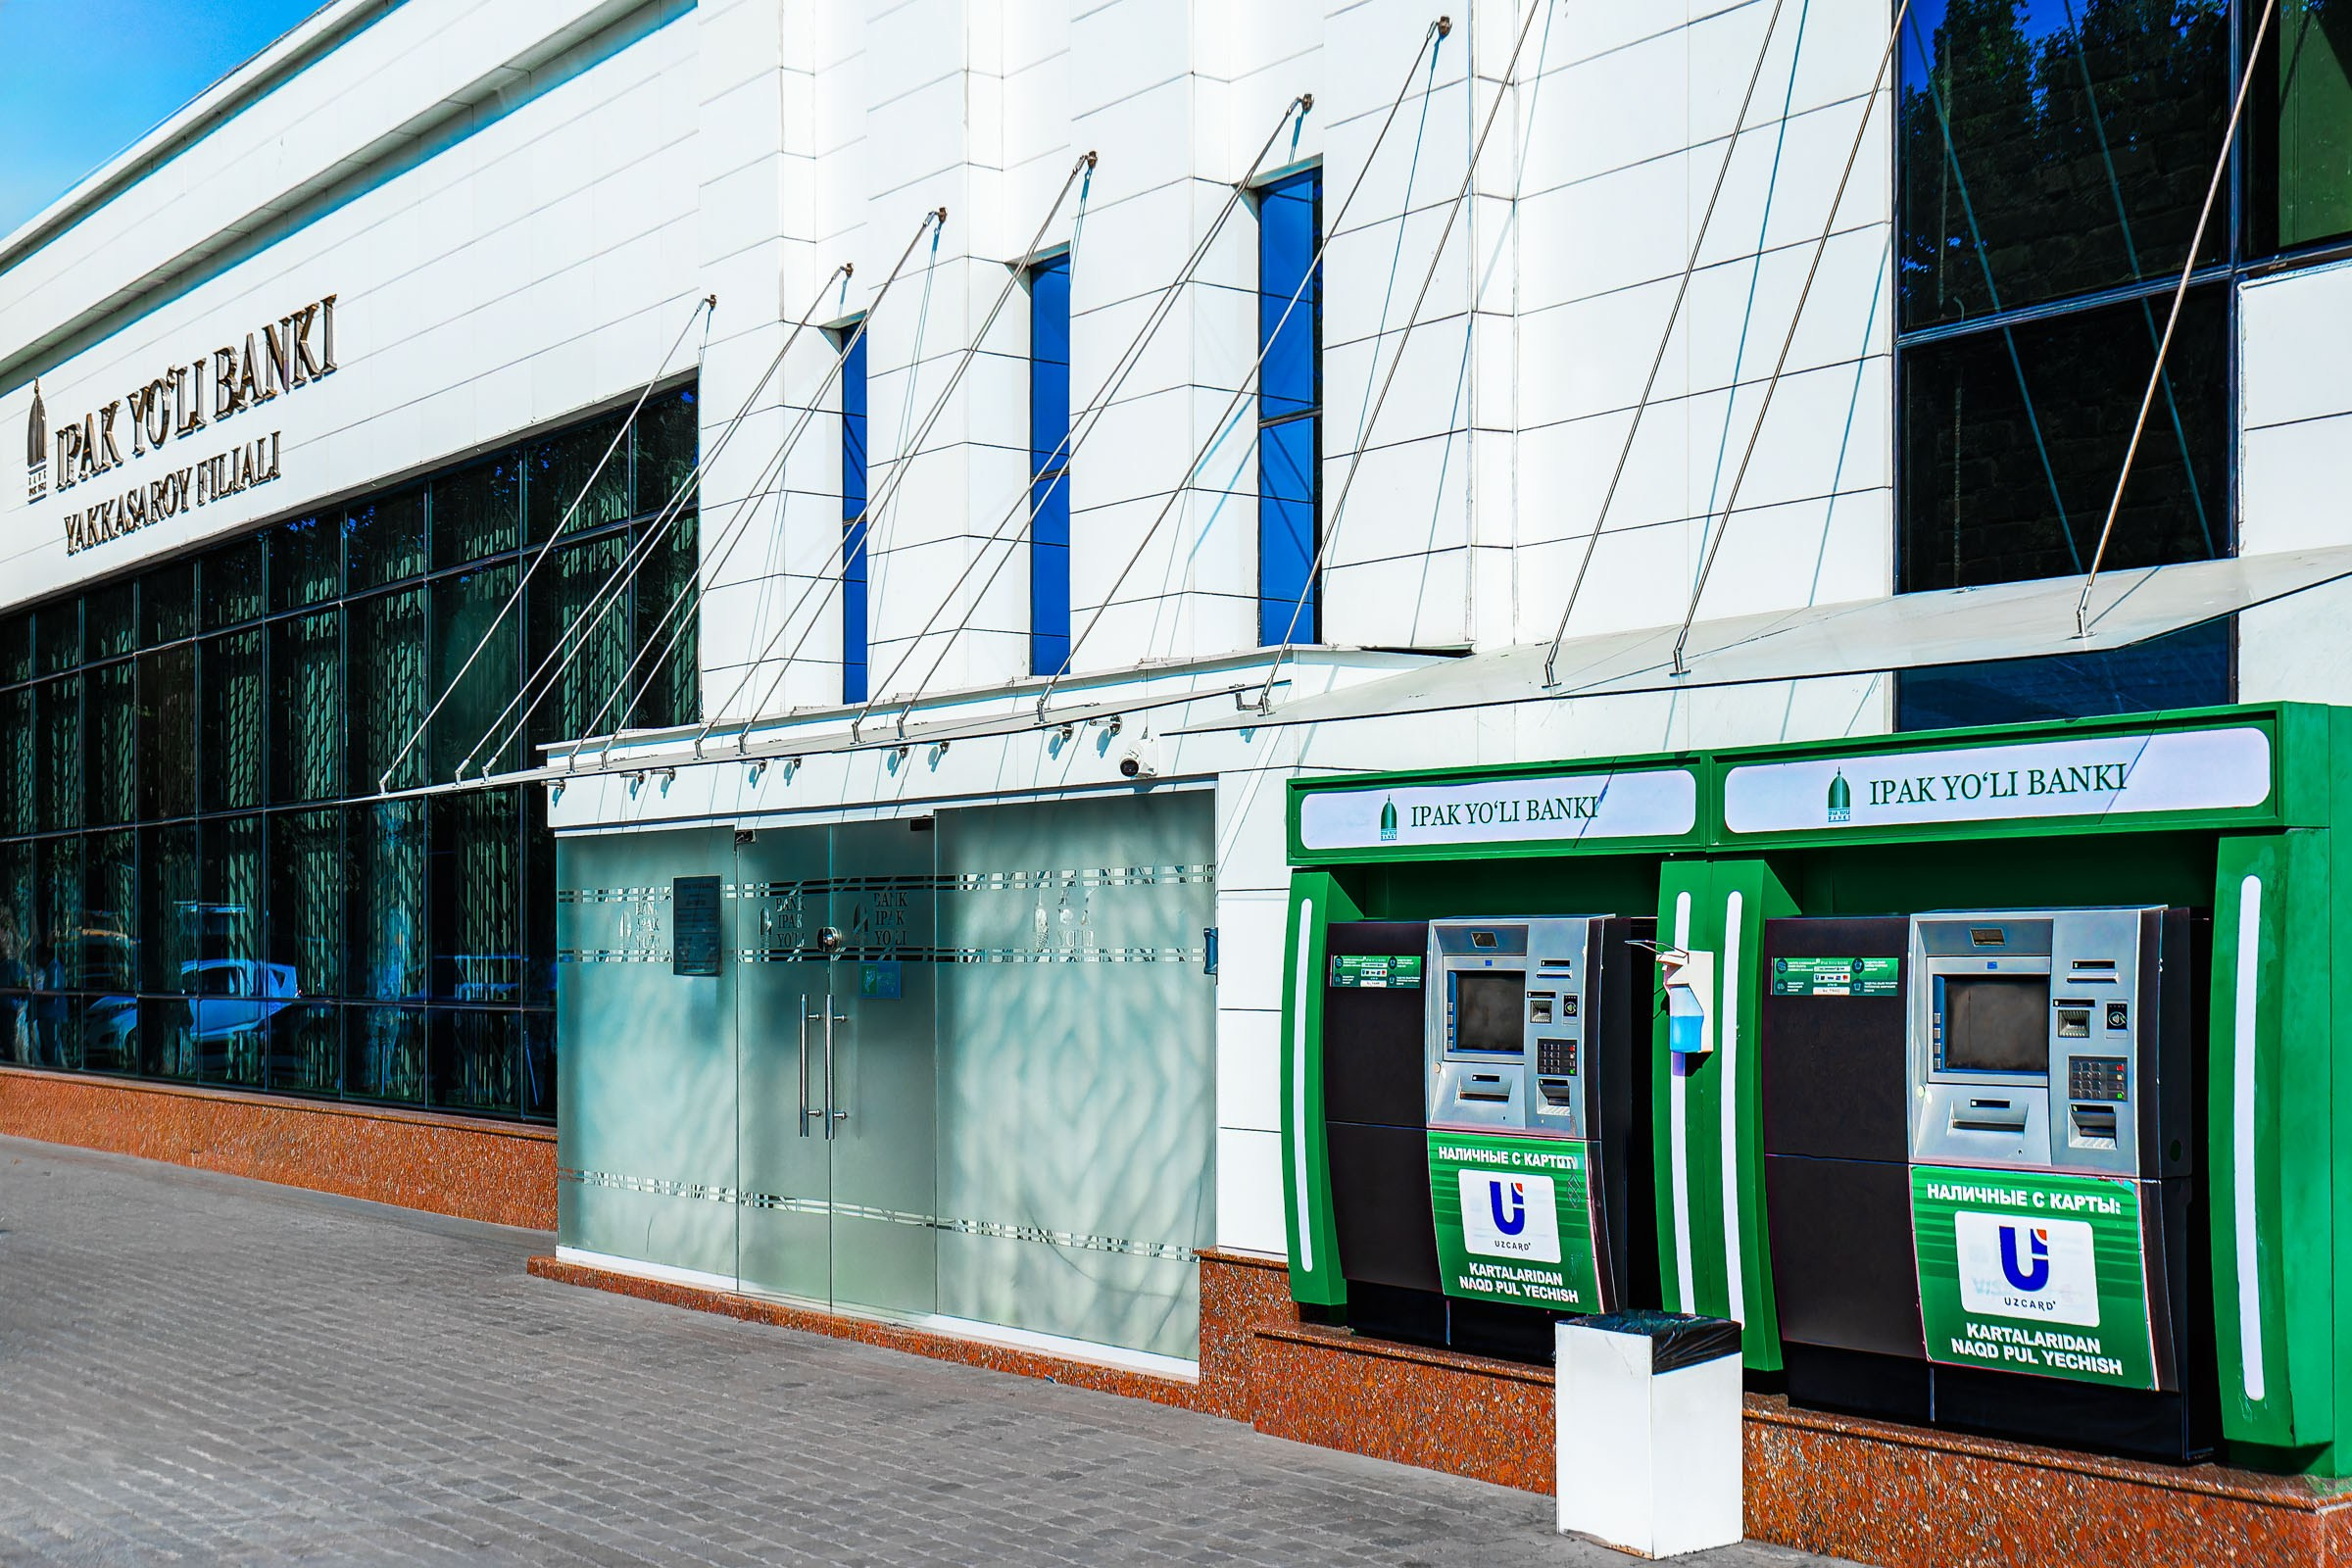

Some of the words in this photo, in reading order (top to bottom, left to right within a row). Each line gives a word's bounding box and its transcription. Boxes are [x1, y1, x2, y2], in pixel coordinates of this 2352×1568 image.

[55, 399, 124, 491] IPAK
[213, 293, 338, 422] BANKI
[64, 466, 194, 556] YAKKASAROY
[195, 431, 281, 508] FILIALI
[1870, 776, 1936, 805] IPAK
[1941, 770, 2019, 801] YO‘LI
[2027, 762, 2128, 796] BANKI
[1411, 804, 1462, 827] IPAK
[1465, 800, 1521, 825] YO‘LI
[1526, 796, 1599, 821] BANKI
[778, 913, 804, 929] IPAK
[1438, 1146, 1509, 1164] НАЛИЧНЫЕ
[1511, 1152, 1521, 1165] С
[1927, 1183, 2028, 1207] НАЛИЧНЫЕ
[2033, 1192, 2044, 1208] С
[2050, 1193, 2122, 1214] КАРТЫ:
[1459, 1275, 1494, 1293] NAQD
[1495, 1281, 1521, 1297] PUL
[1522, 1284, 1580, 1303] YECHISH
[1469, 1262, 1563, 1287] KARTALARIDAN
[1966, 1322, 2101, 1354] KARTALARIDAN
[1950, 1338, 1999, 1359] NAQD
[2003, 1347, 2038, 1365] PUL
[2041, 1348, 2124, 1376] YECHISH
